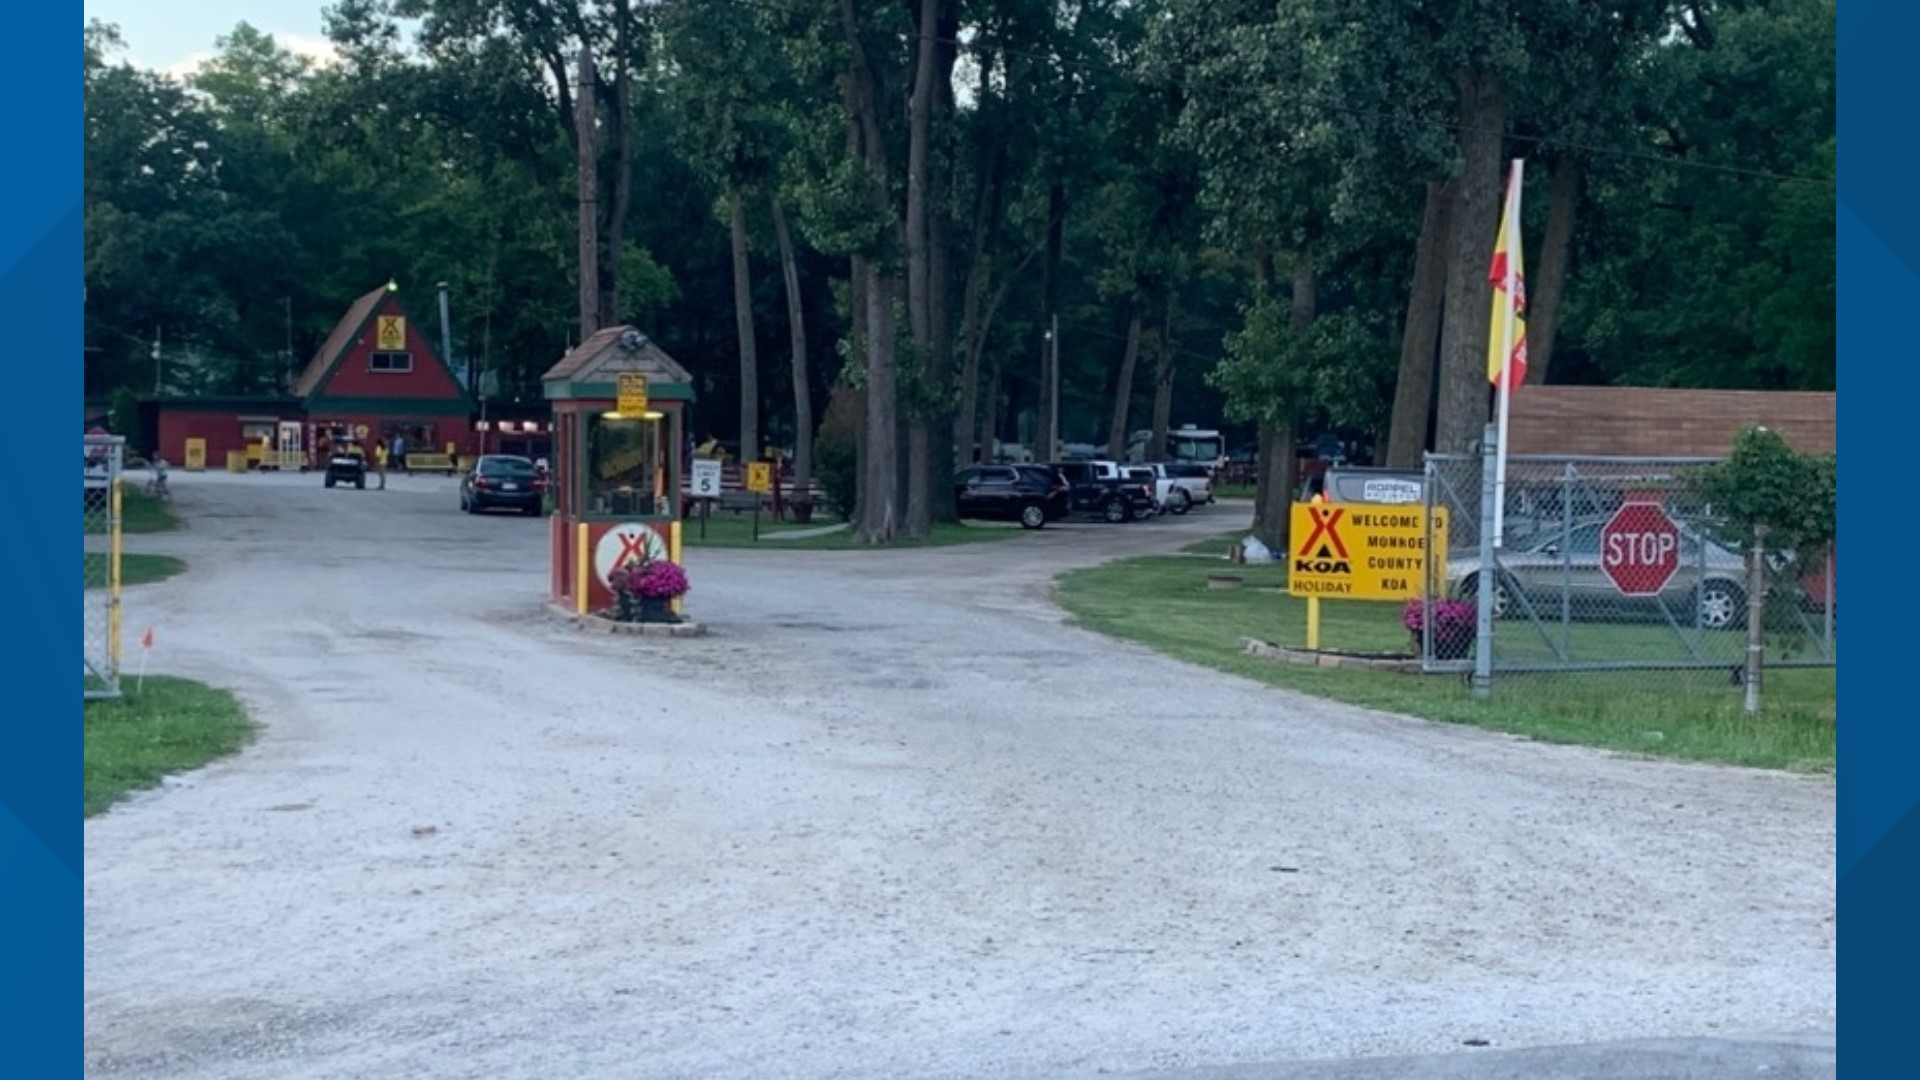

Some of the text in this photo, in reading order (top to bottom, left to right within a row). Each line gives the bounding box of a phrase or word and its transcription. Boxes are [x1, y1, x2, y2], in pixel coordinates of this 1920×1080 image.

[701, 478, 711, 492] 5
[1352, 514, 1419, 528] WELCOME
[1367, 535, 1426, 549] MONROE
[1607, 533, 1675, 566] STOP
[1296, 560, 1351, 574] KOA
[1368, 556, 1423, 569] COUNTY
[1293, 581, 1353, 594] HOLIDAY
[1382, 578, 1407, 591] KOA
